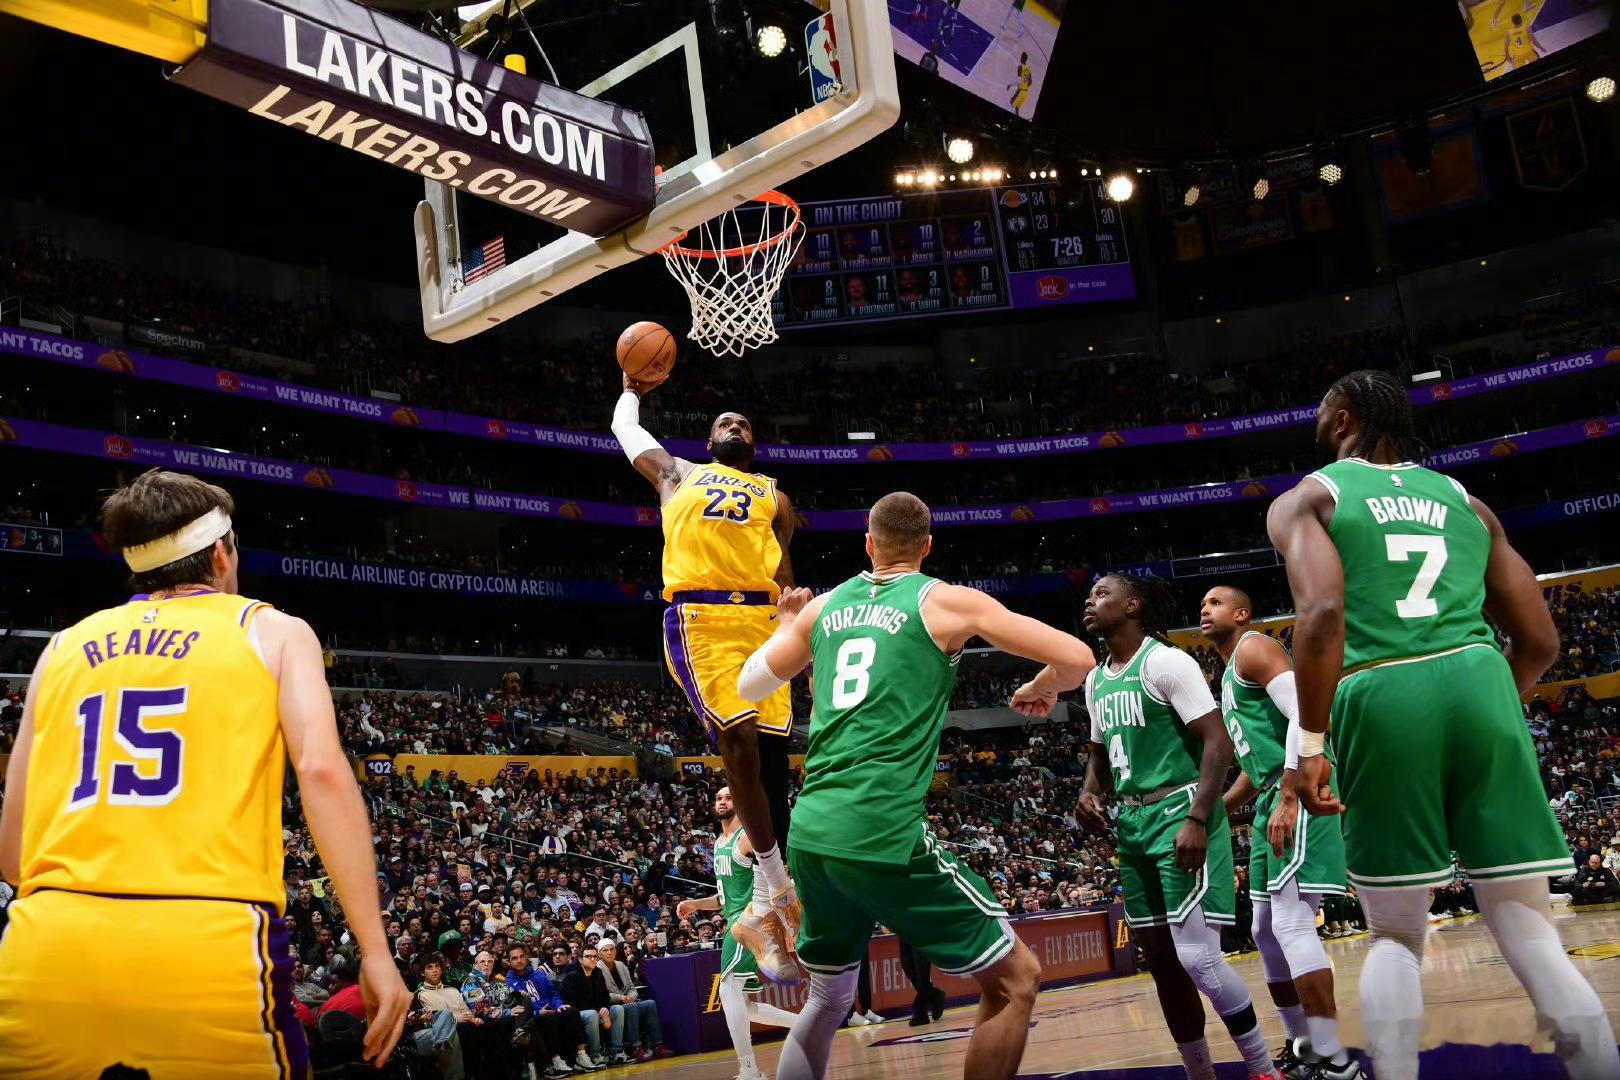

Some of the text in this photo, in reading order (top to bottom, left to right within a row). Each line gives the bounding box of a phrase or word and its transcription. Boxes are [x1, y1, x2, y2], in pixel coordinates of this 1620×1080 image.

[283, 14, 606, 181] LAKERS.COM
[247, 84, 592, 220] LAKERS.COM
[1032, 191, 1045, 206] 34
[815, 201, 903, 225] ON THE COURT
[1036, 214, 1049, 230] 23
[1101, 208, 1115, 224] 30
[920, 224, 933, 240] 10
[974, 220, 982, 236] 2
[816, 233, 830, 248] 10
[1050, 236, 1084, 258] 7:26
[876, 275, 887, 291] 11
[929, 271, 938, 286] 3
[1038, 279, 1064, 298] Jack
[1077, 281, 1091, 289] the
[30, 337, 84, 360] TACOS
[147, 329, 206, 352] Spectrum
[1483, 355, 1594, 387] WE WANT TACOS
[275, 385, 382, 417] WE WANT TACOS
[1232, 420, 1252, 431] WE
[1254, 414, 1290, 428] WANT
[535, 429, 555, 442] WE
[556, 432, 589, 447] WANT
[590, 437, 623, 451] TACO
[996, 437, 1090, 455] WE WANT TACOS
[173, 449, 294, 480] WE WANT TACOS
[768, 447, 786, 459] WE
[787, 448, 821, 460] WANT
[822, 448, 859, 460] TACOS
[1439, 448, 1480, 465] TACOS
[693, 472, 766, 498] LAKERS
[1139, 495, 1159, 506] WE
[1160, 491, 1195, 504] WANT
[1196, 487, 1233, 500] TACOS
[448, 490, 550, 512] WE WANT TACOS
[702, 487, 752, 525] 23
[1563, 493, 1620, 516] OFFICIA
[932, 510, 1002, 523] WANT TACOS
[1366, 496, 1448, 530] BROWN
[281, 557, 348, 580] OFFICIAL
[352, 564, 406, 586] AIRLINE
[409, 570, 425, 588] OF
[430, 572, 518, 594] CRYPTO.COM
[1200, 561, 1251, 573] Congratulations
[1385, 533, 1449, 619] 7
[821, 604, 909, 638] PORZINGIS
[83, 628, 200, 669] REAVES
[832, 637, 876, 710] 8
[1095, 690, 1146, 732] OSTON
[1226, 716, 1251, 759] 2
[65, 684, 190, 815] 15
[1109, 732, 1132, 781] 4
[369, 761, 391, 775] 102
[1045, 935, 1063, 966] FLY
[1066, 930, 1104, 961] BETTER
